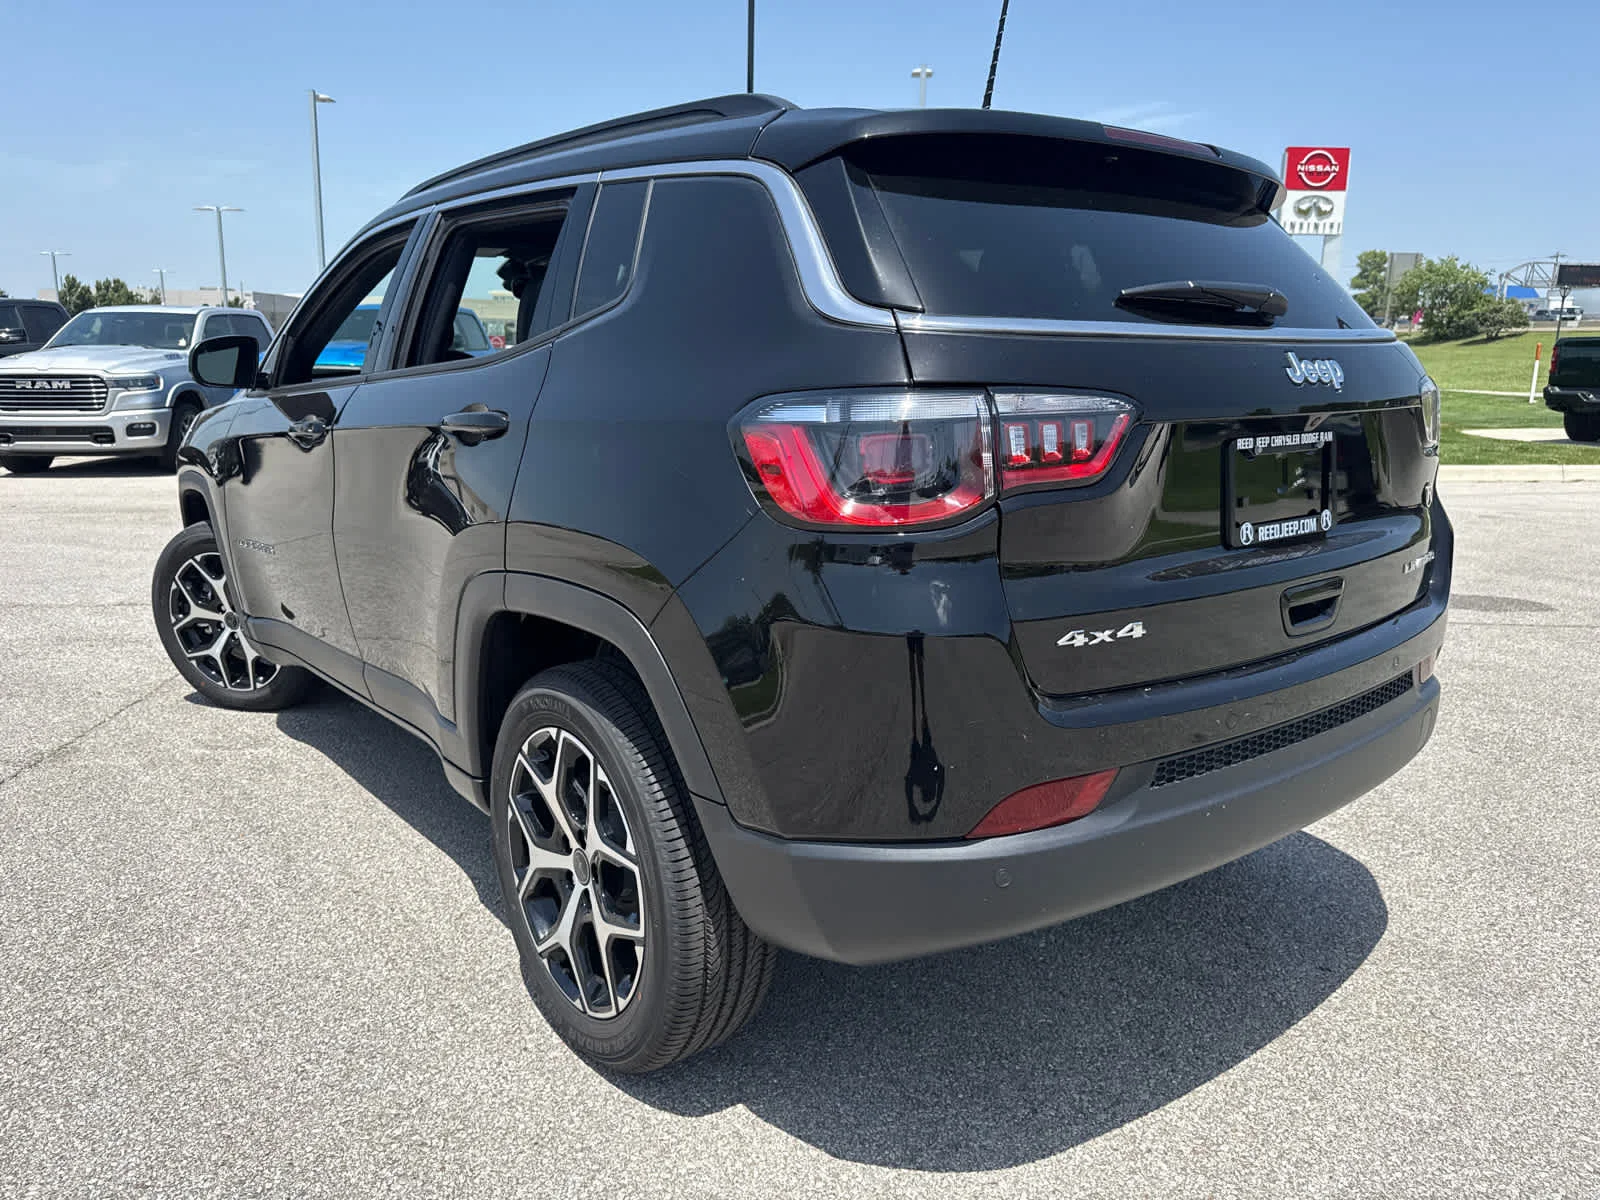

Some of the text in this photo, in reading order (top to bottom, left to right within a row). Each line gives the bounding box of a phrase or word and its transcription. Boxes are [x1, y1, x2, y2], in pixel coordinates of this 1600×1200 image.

[1297, 164, 1339, 172] NISSAN
[1285, 351, 1345, 389] Jeep
[15, 380, 72, 389] RAM
[1236, 431, 1333, 450] REED JEEP CHRYSLER DODGE RAM
[1258, 518, 1316, 541] REEDJEEP.COM
[1056, 621, 1147, 648] 4x4
